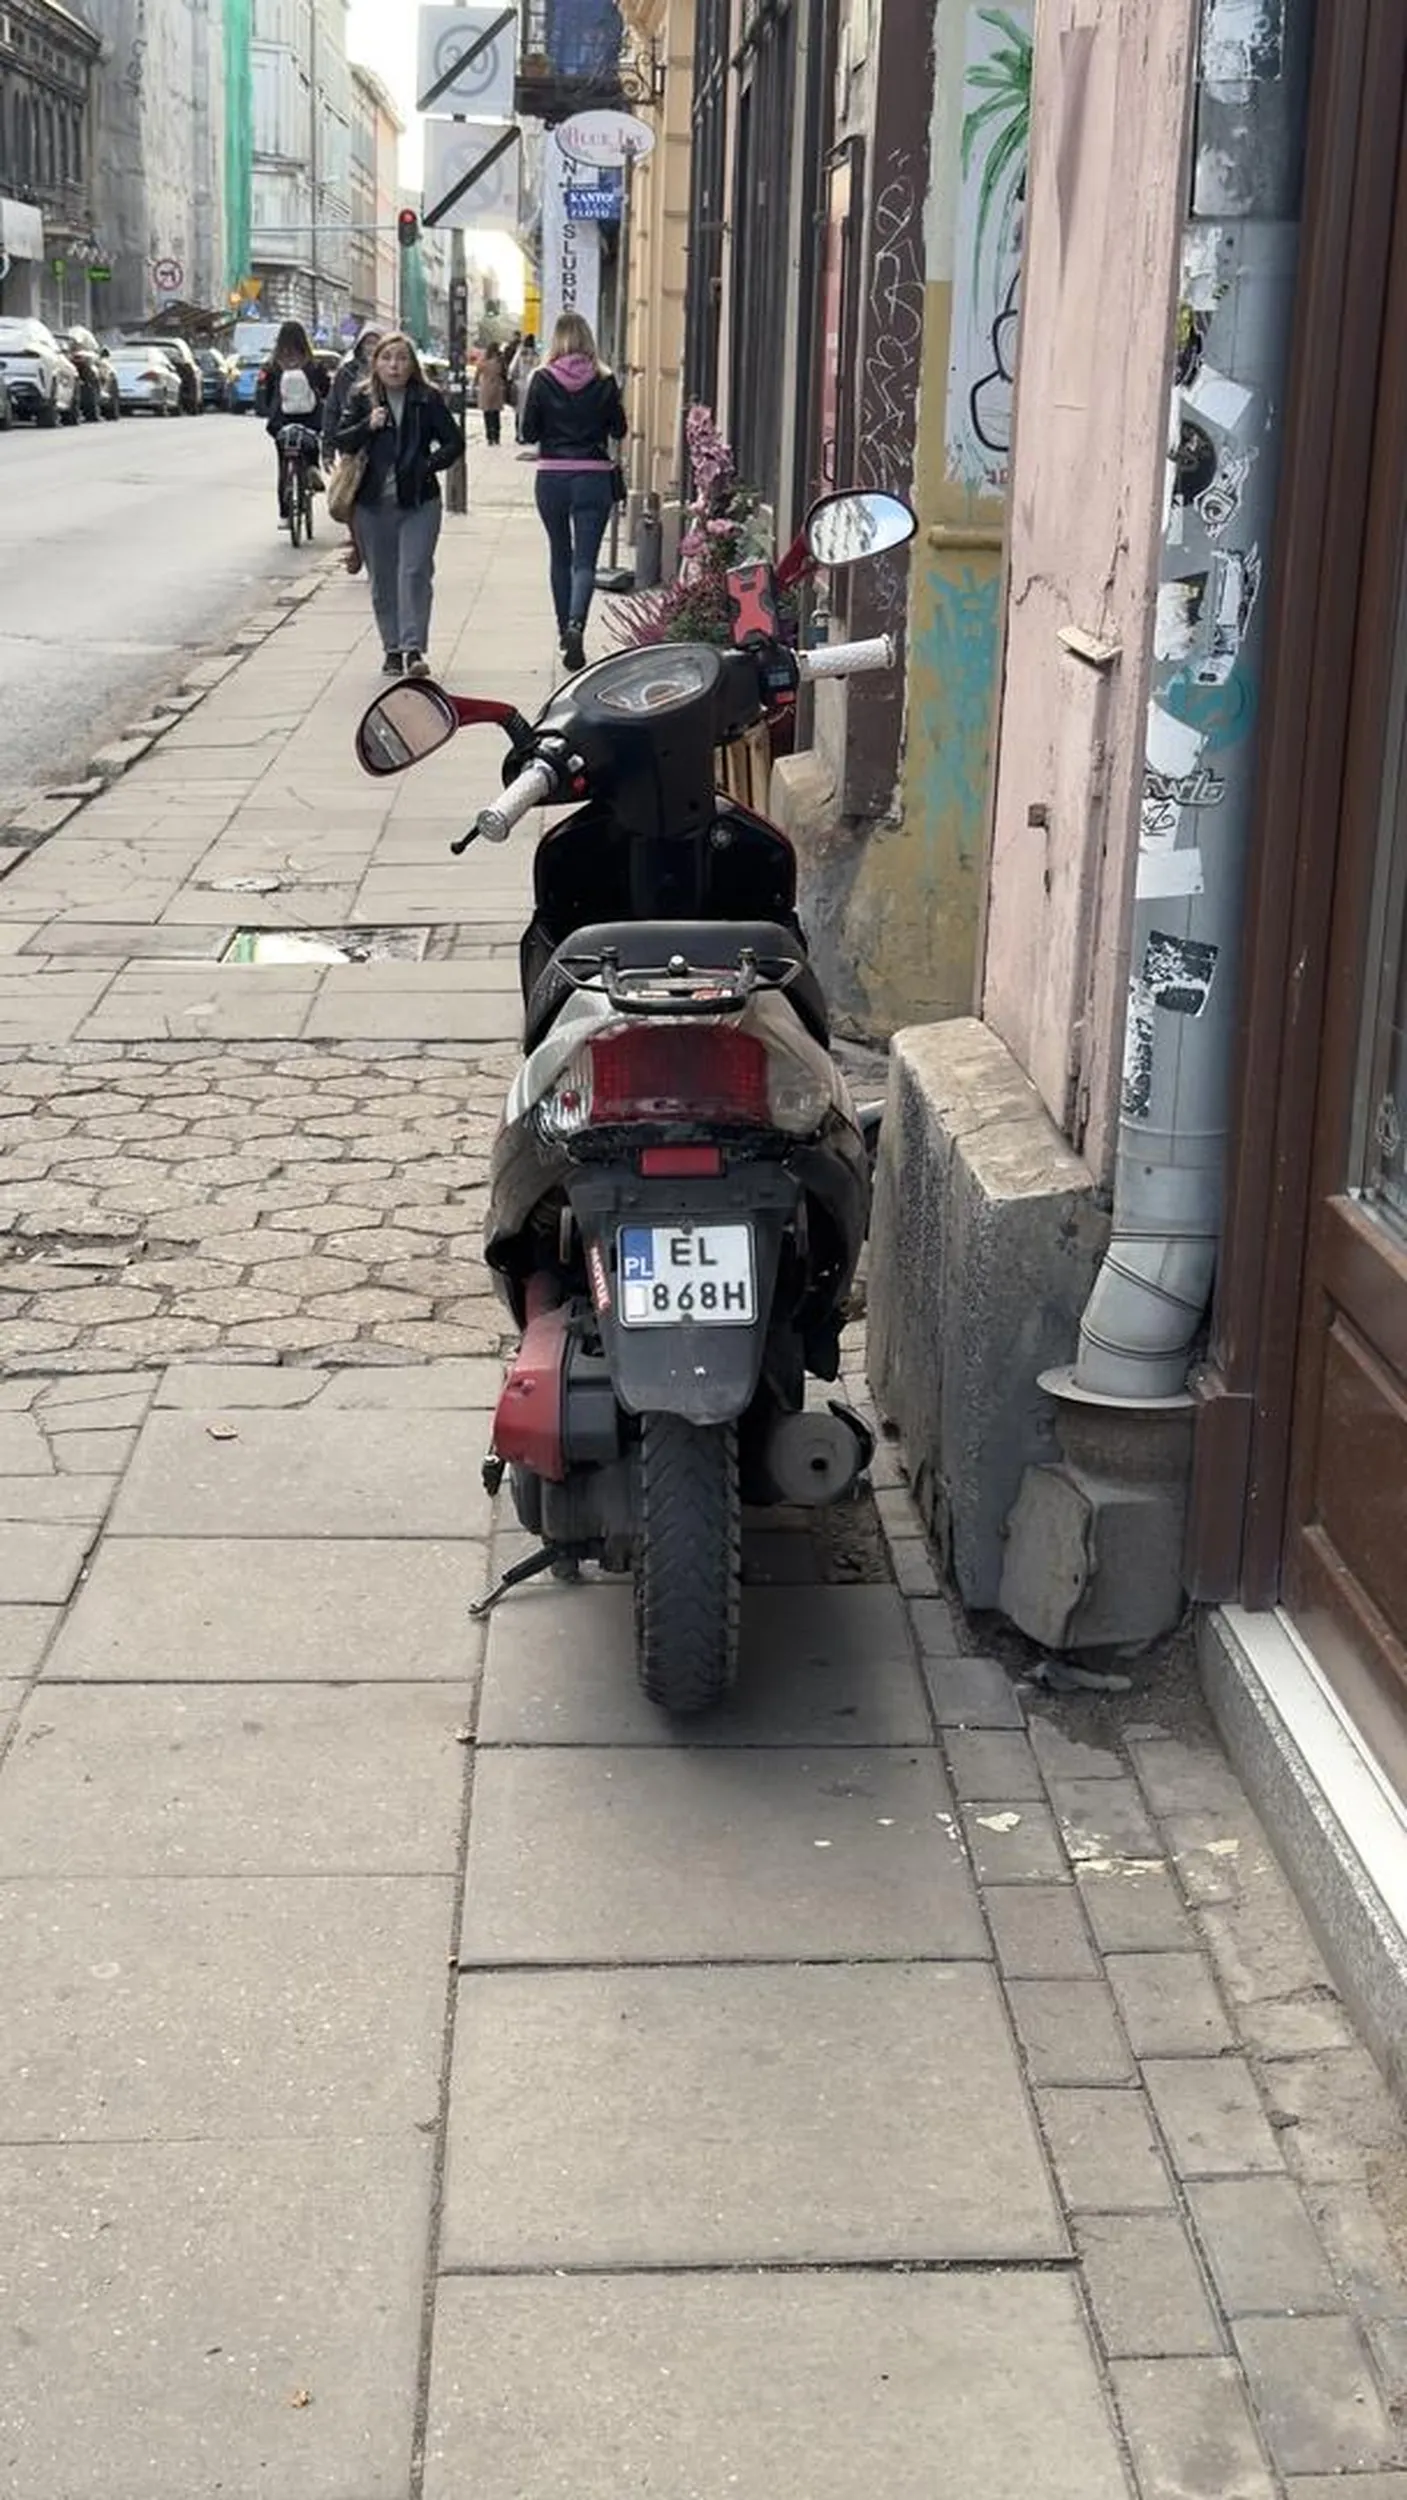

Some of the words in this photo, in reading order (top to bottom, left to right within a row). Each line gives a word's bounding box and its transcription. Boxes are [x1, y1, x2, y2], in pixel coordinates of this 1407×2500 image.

[670, 1237, 718, 1266] EL
[624, 1257, 653, 1277] PL
[652, 1281, 746, 1312] 868H
